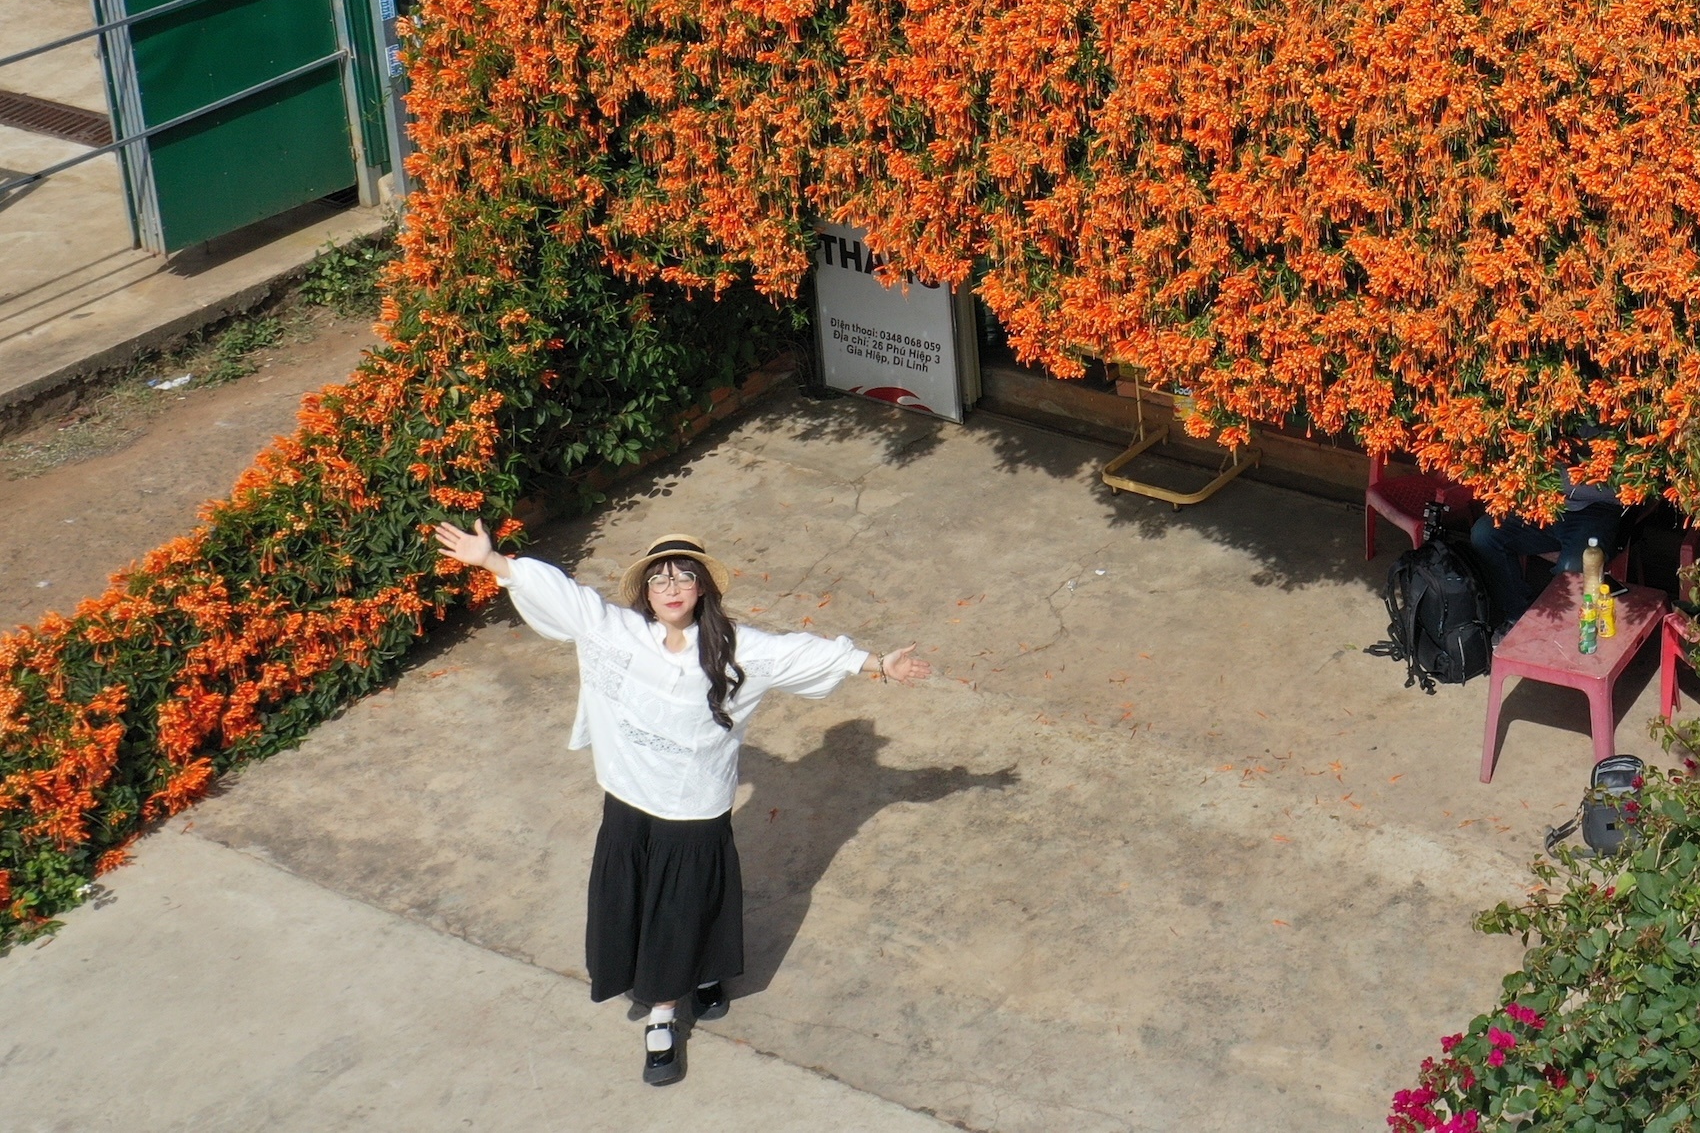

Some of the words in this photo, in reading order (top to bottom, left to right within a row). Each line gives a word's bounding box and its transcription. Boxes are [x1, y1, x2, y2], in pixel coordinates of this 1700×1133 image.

[830, 317, 850, 331] Điện
[880, 330, 902, 343] 0348
[904, 336, 922, 348] 068
[924, 340, 941, 353] 059
[833, 329, 849, 343] Địa
[886, 343, 906, 356] Phú
[909, 348, 932, 363] Hiệp
[934, 354, 941, 365] 3
[846, 344, 863, 356] Gia
[893, 356, 904, 367] Di
[906, 359, 929, 373] Linh
